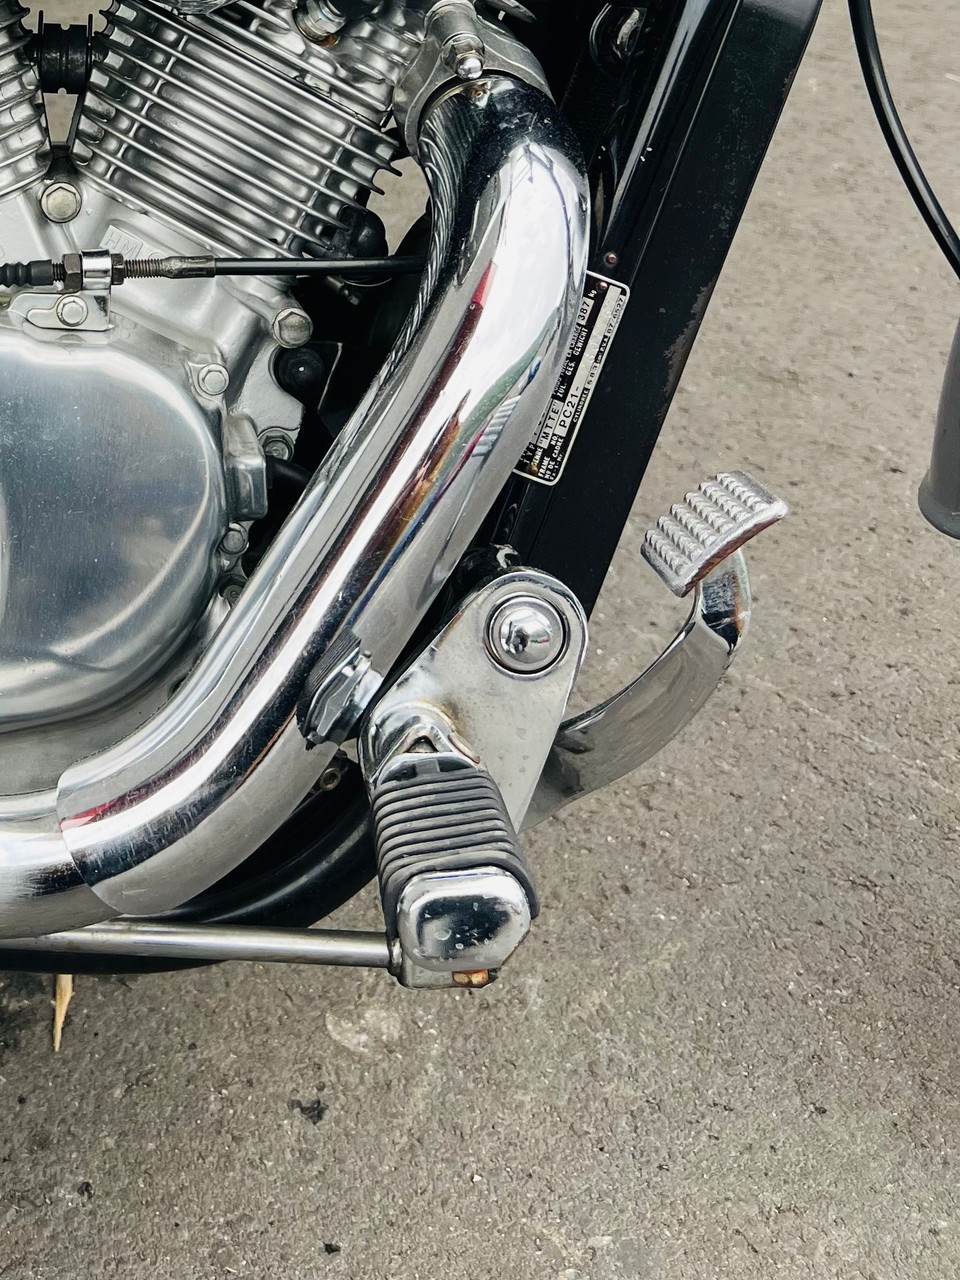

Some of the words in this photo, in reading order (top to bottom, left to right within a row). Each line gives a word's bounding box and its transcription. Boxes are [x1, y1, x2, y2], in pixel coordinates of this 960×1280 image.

[577, 300, 590, 321] 387
[587, 288, 597, 298] kg
[572, 326, 588, 356] GEWICHT
[551, 436, 564, 458] CADRE
[537, 454, 550, 477] FRAME
[547, 459, 556, 469] DE
